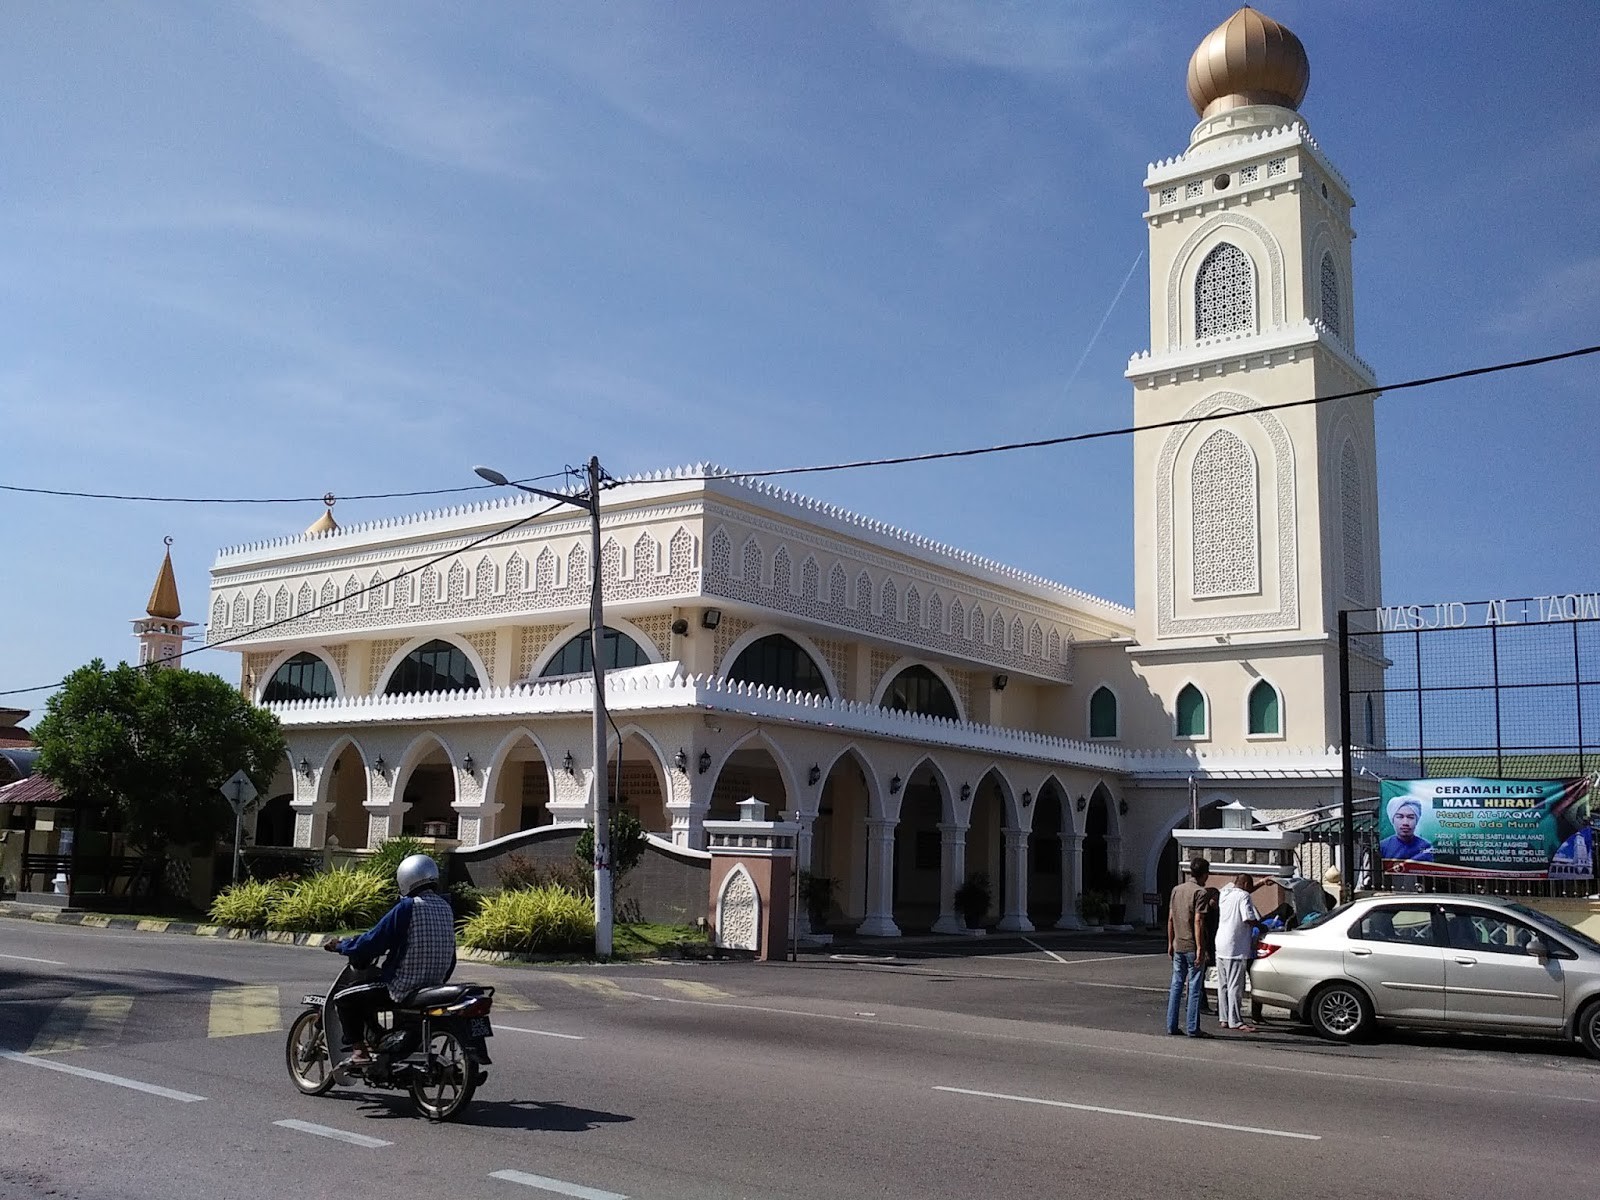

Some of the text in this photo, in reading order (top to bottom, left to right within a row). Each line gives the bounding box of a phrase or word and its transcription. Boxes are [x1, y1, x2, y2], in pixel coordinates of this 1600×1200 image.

[1376, 602, 1466, 631] MASJID
[1435, 786, 1544, 794] CERAMAH KHAS
[1442, 799, 1535, 808] MAAL HIJRAH
[1436, 811, 1542, 819] Masjid AT-TAQWA
[1439, 820, 1475, 828] Taman
[1507, 821, 1540, 829] Murni
